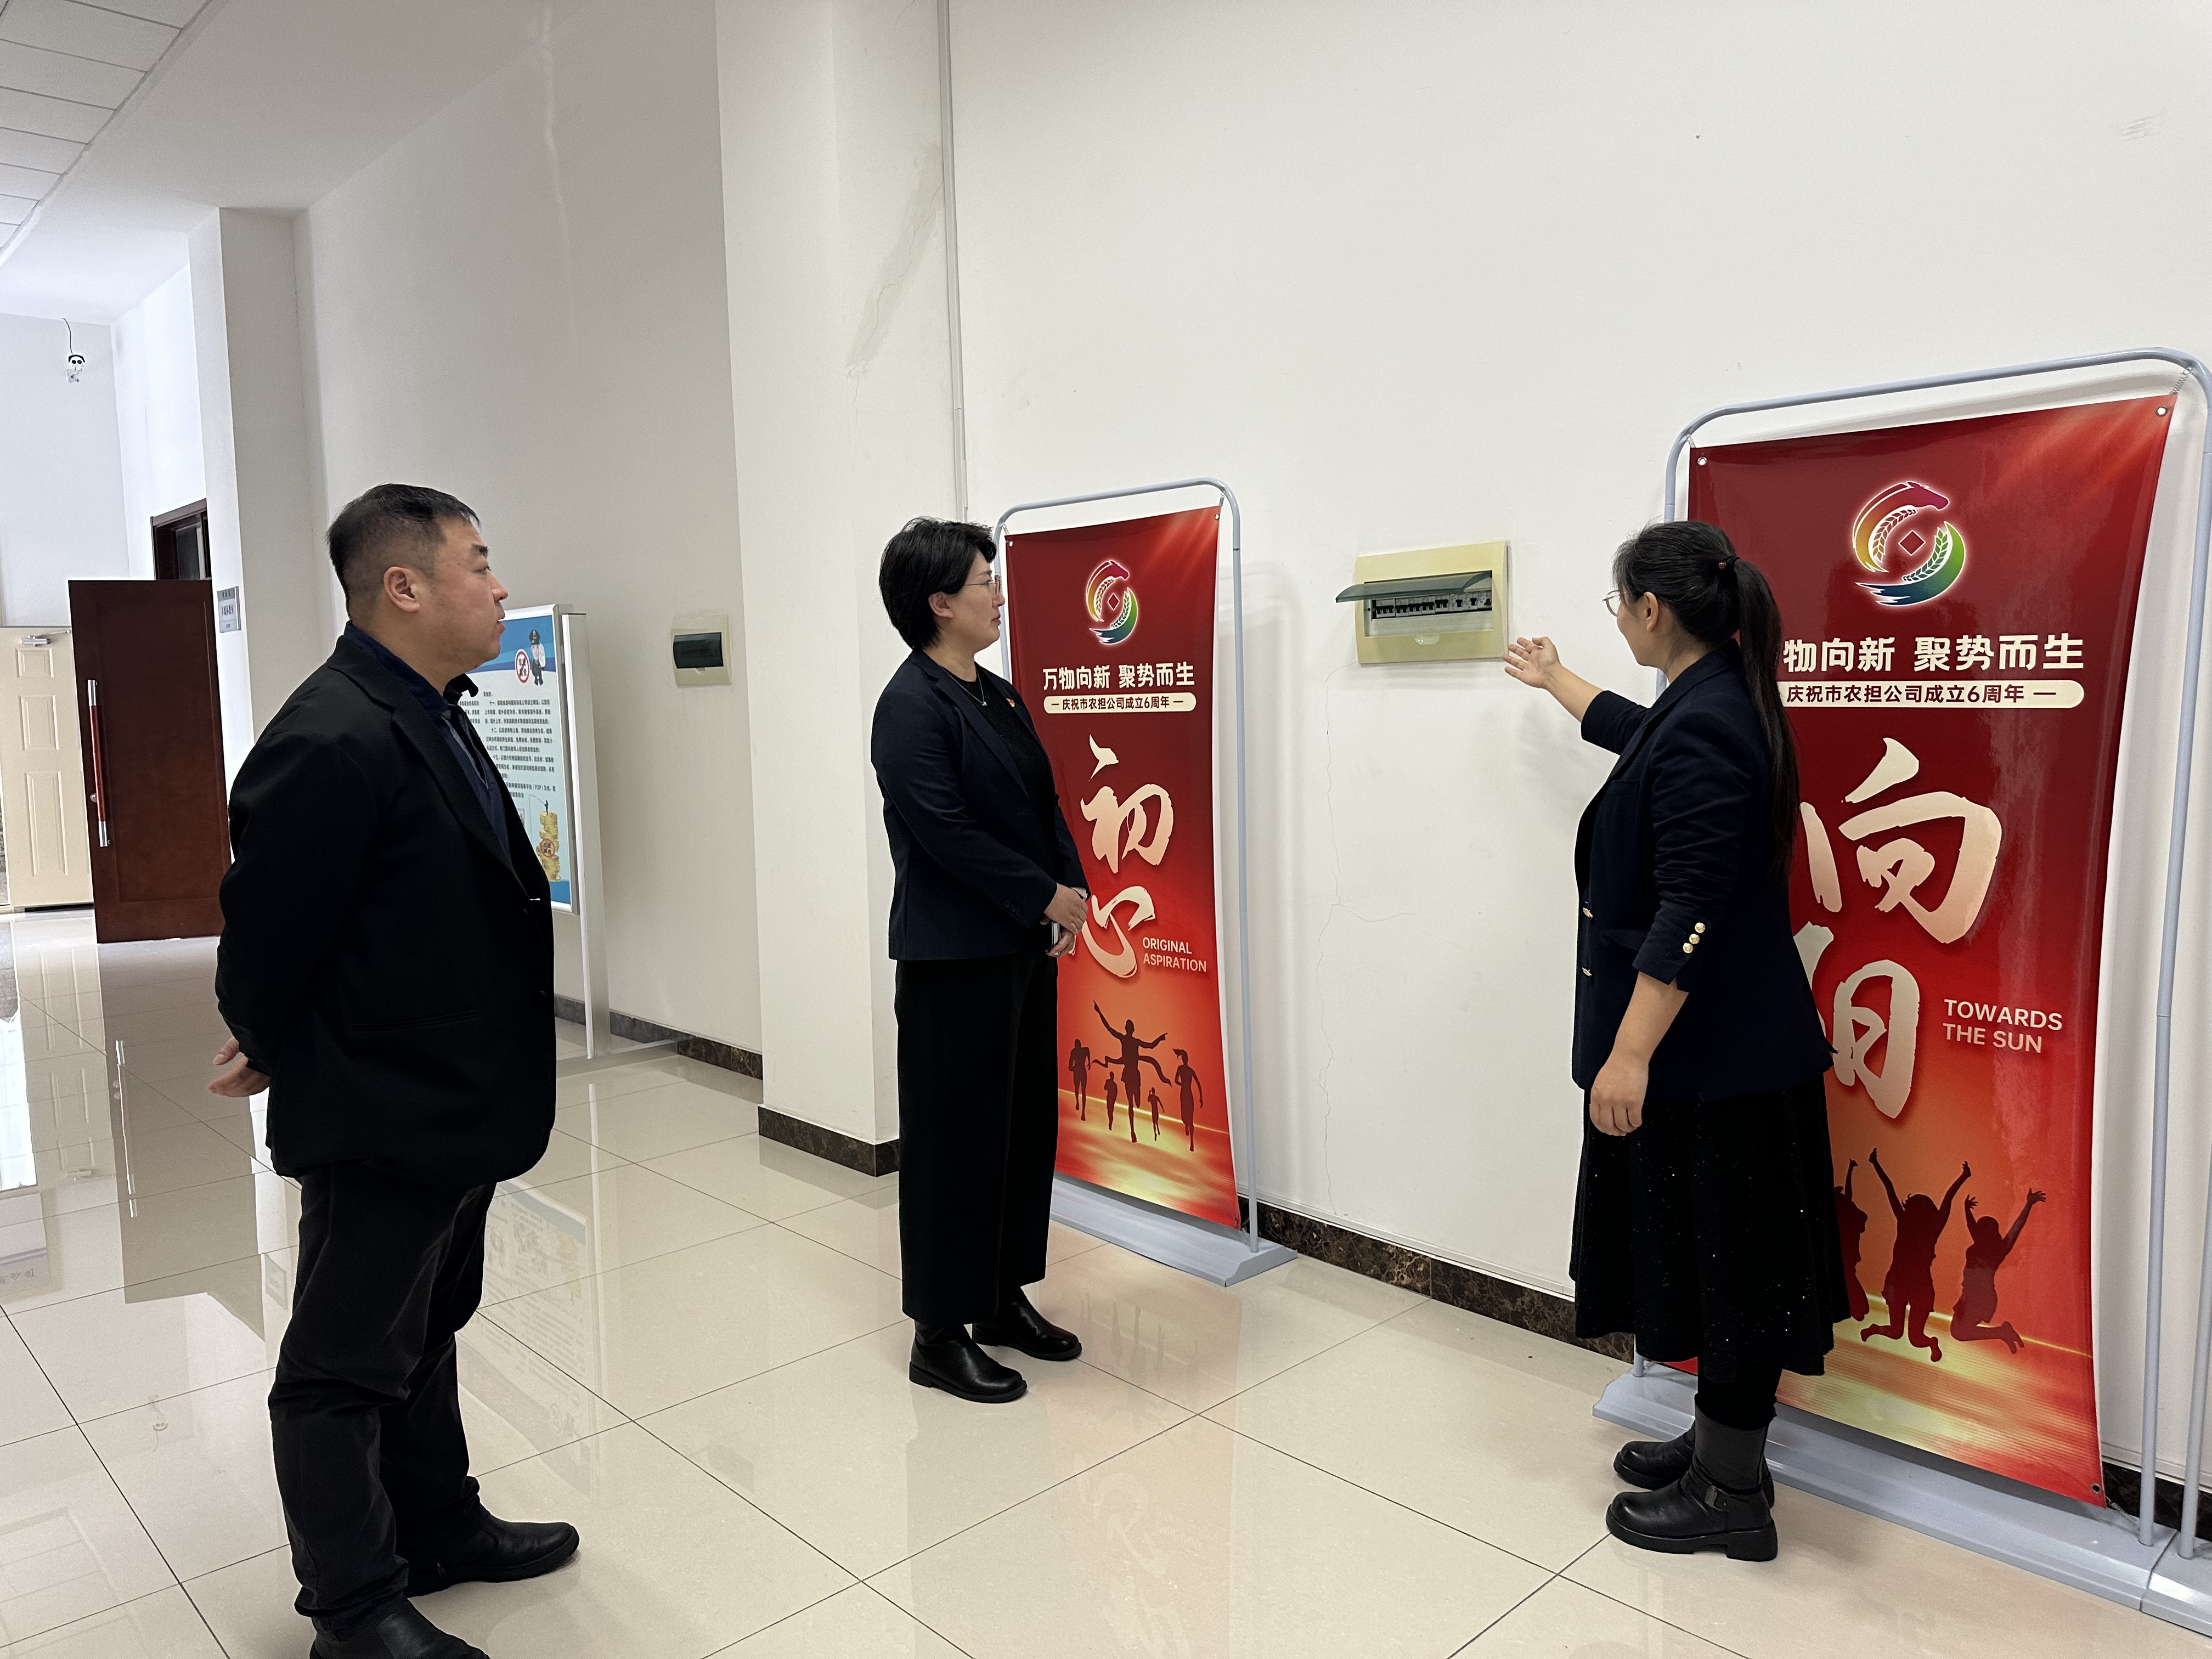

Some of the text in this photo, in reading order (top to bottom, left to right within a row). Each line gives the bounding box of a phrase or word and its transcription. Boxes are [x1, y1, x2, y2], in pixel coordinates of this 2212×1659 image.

[1783, 633, 2084, 673] 物向新 聚势而生
[1042, 661, 1195, 691] 万物向新 聚势而生
[1142, 936, 1192, 955] ORIGINAL
[1143, 952, 1206, 973] ASPIRATION
[1944, 998, 2062, 1031] TOWARDS
[1943, 1023, 2042, 1053] THE SUN
